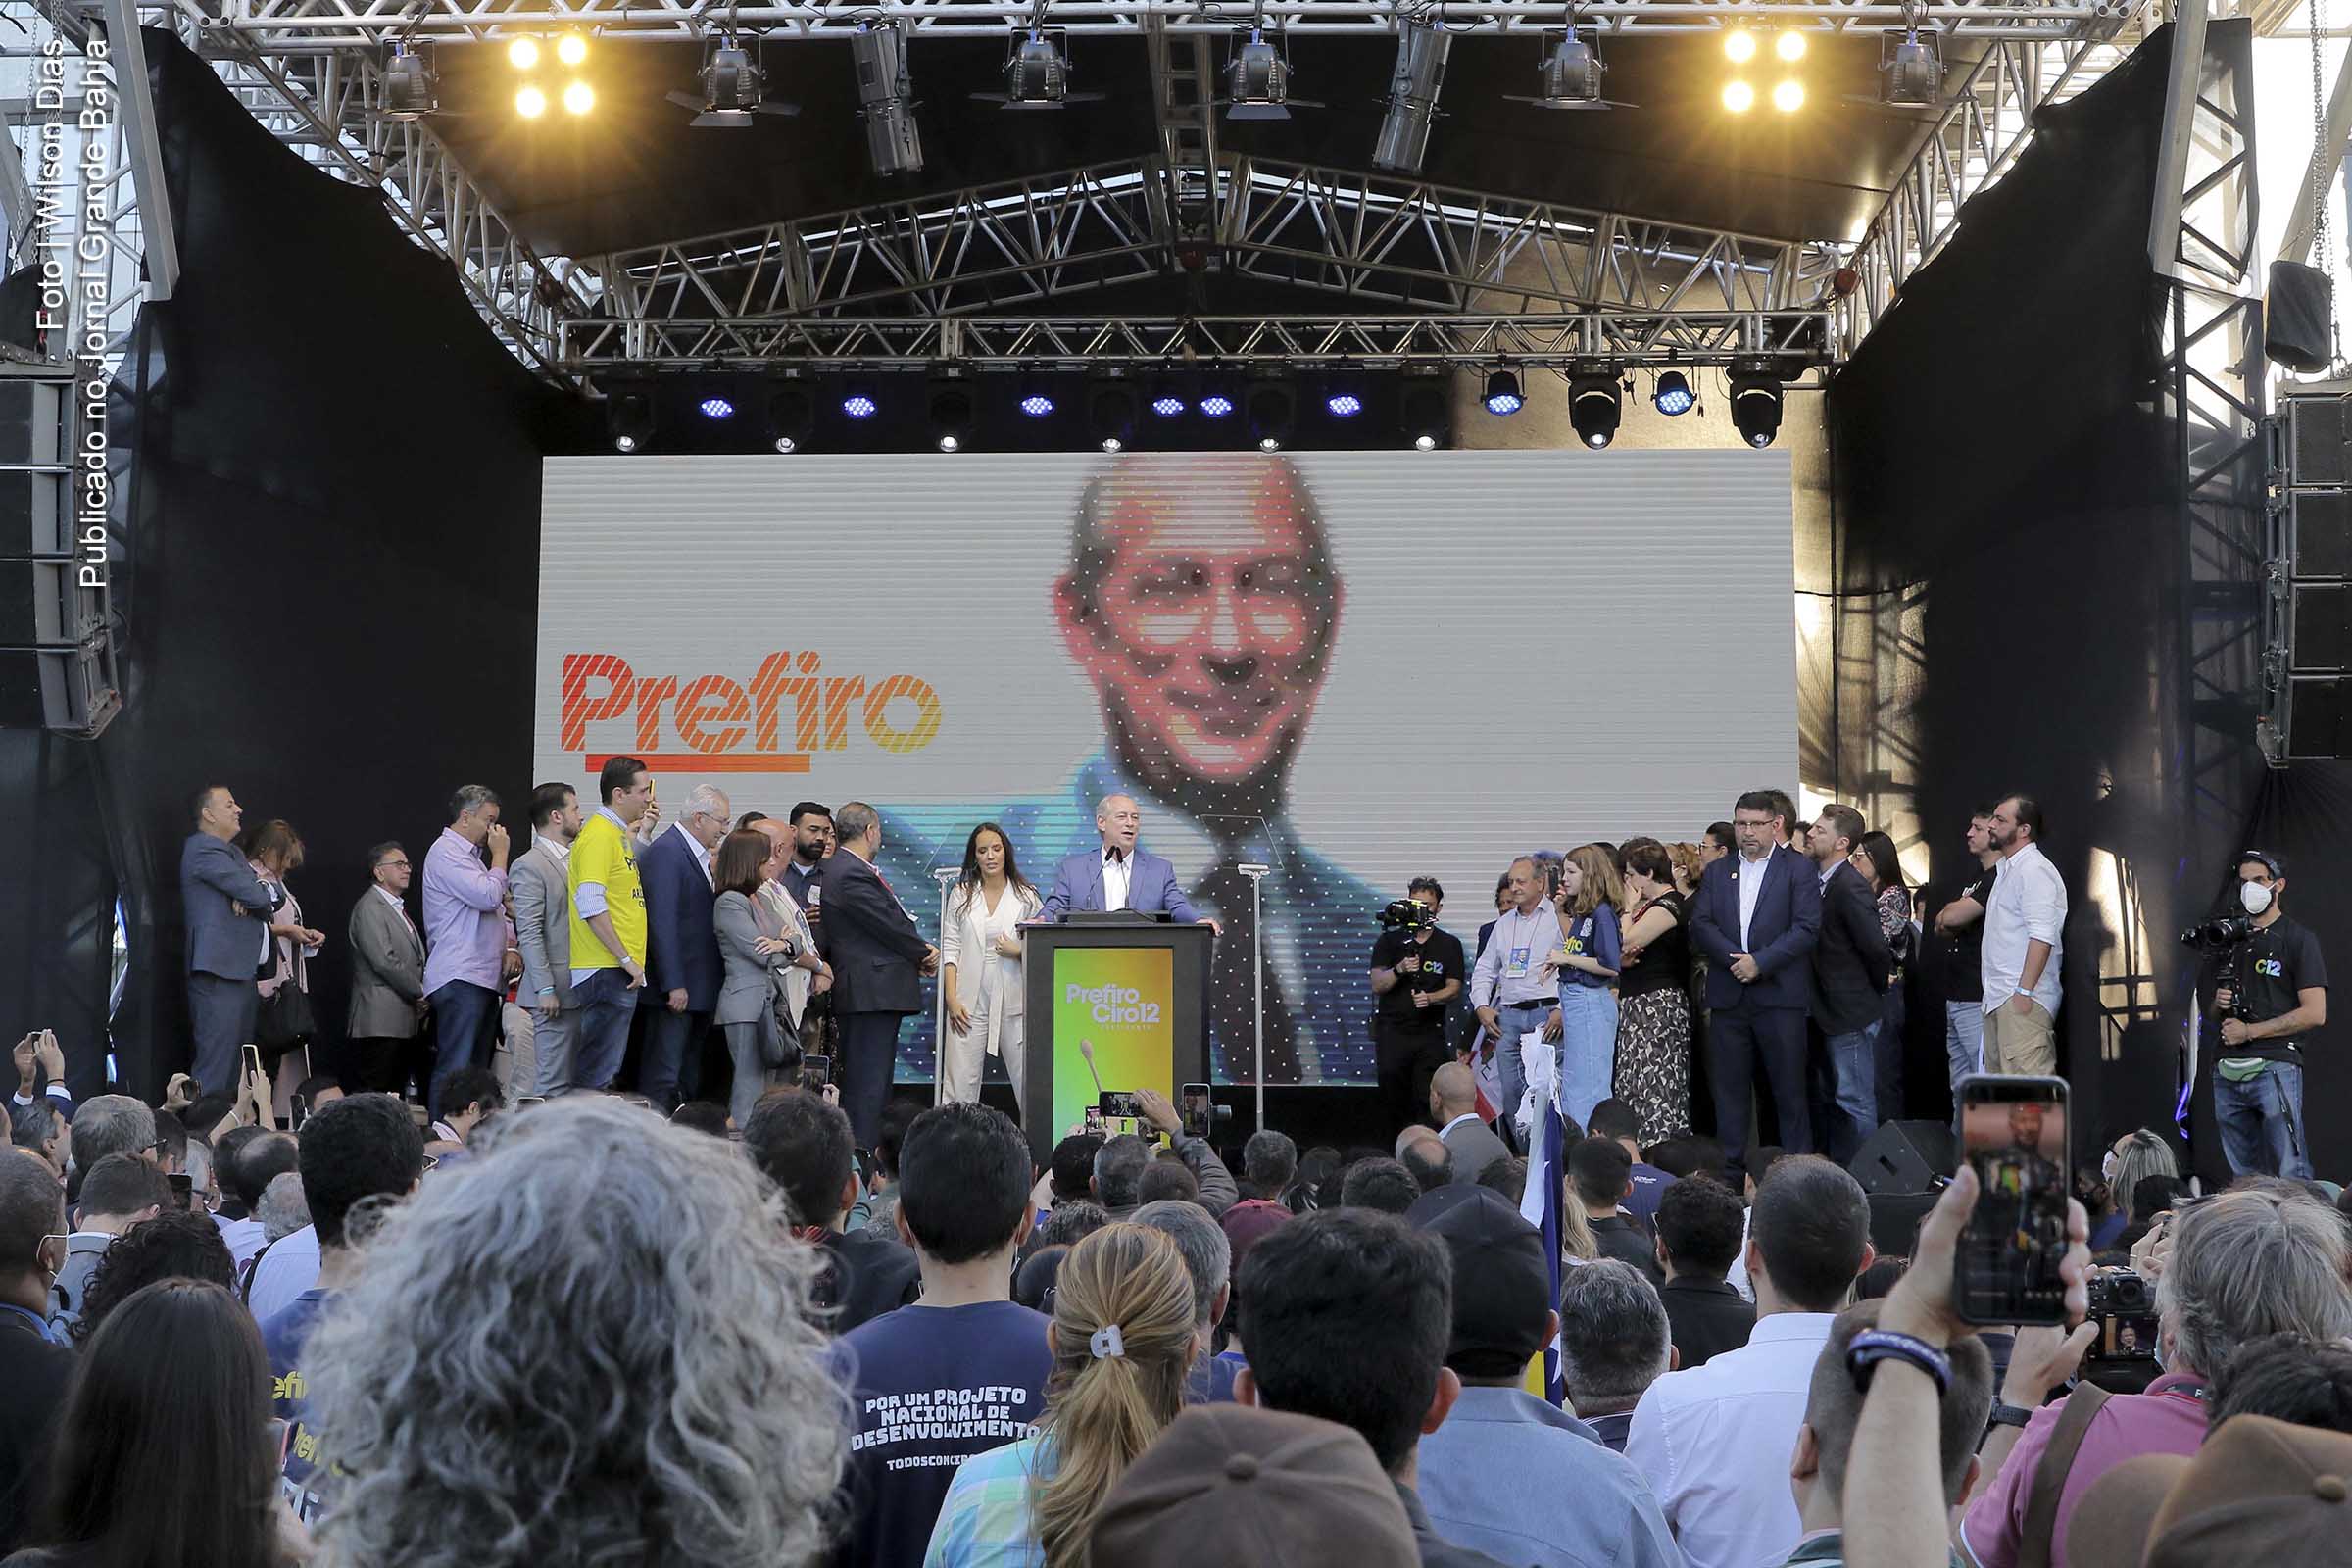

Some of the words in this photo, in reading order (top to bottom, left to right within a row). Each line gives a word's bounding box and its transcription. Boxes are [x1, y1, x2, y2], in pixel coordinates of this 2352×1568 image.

[560, 650, 943, 754] Prefiro
[1065, 983, 1140, 1004] Prefiro
[865, 1395, 901, 1414] POR
[904, 1393, 930, 1407] UM
[934, 1386, 1027, 1406] PROJETO
[881, 1403, 983, 1427] NACIONAL
[987, 1405, 1010, 1420] DE
[851, 1420, 1041, 1451] DESENVOLVIMENTO
